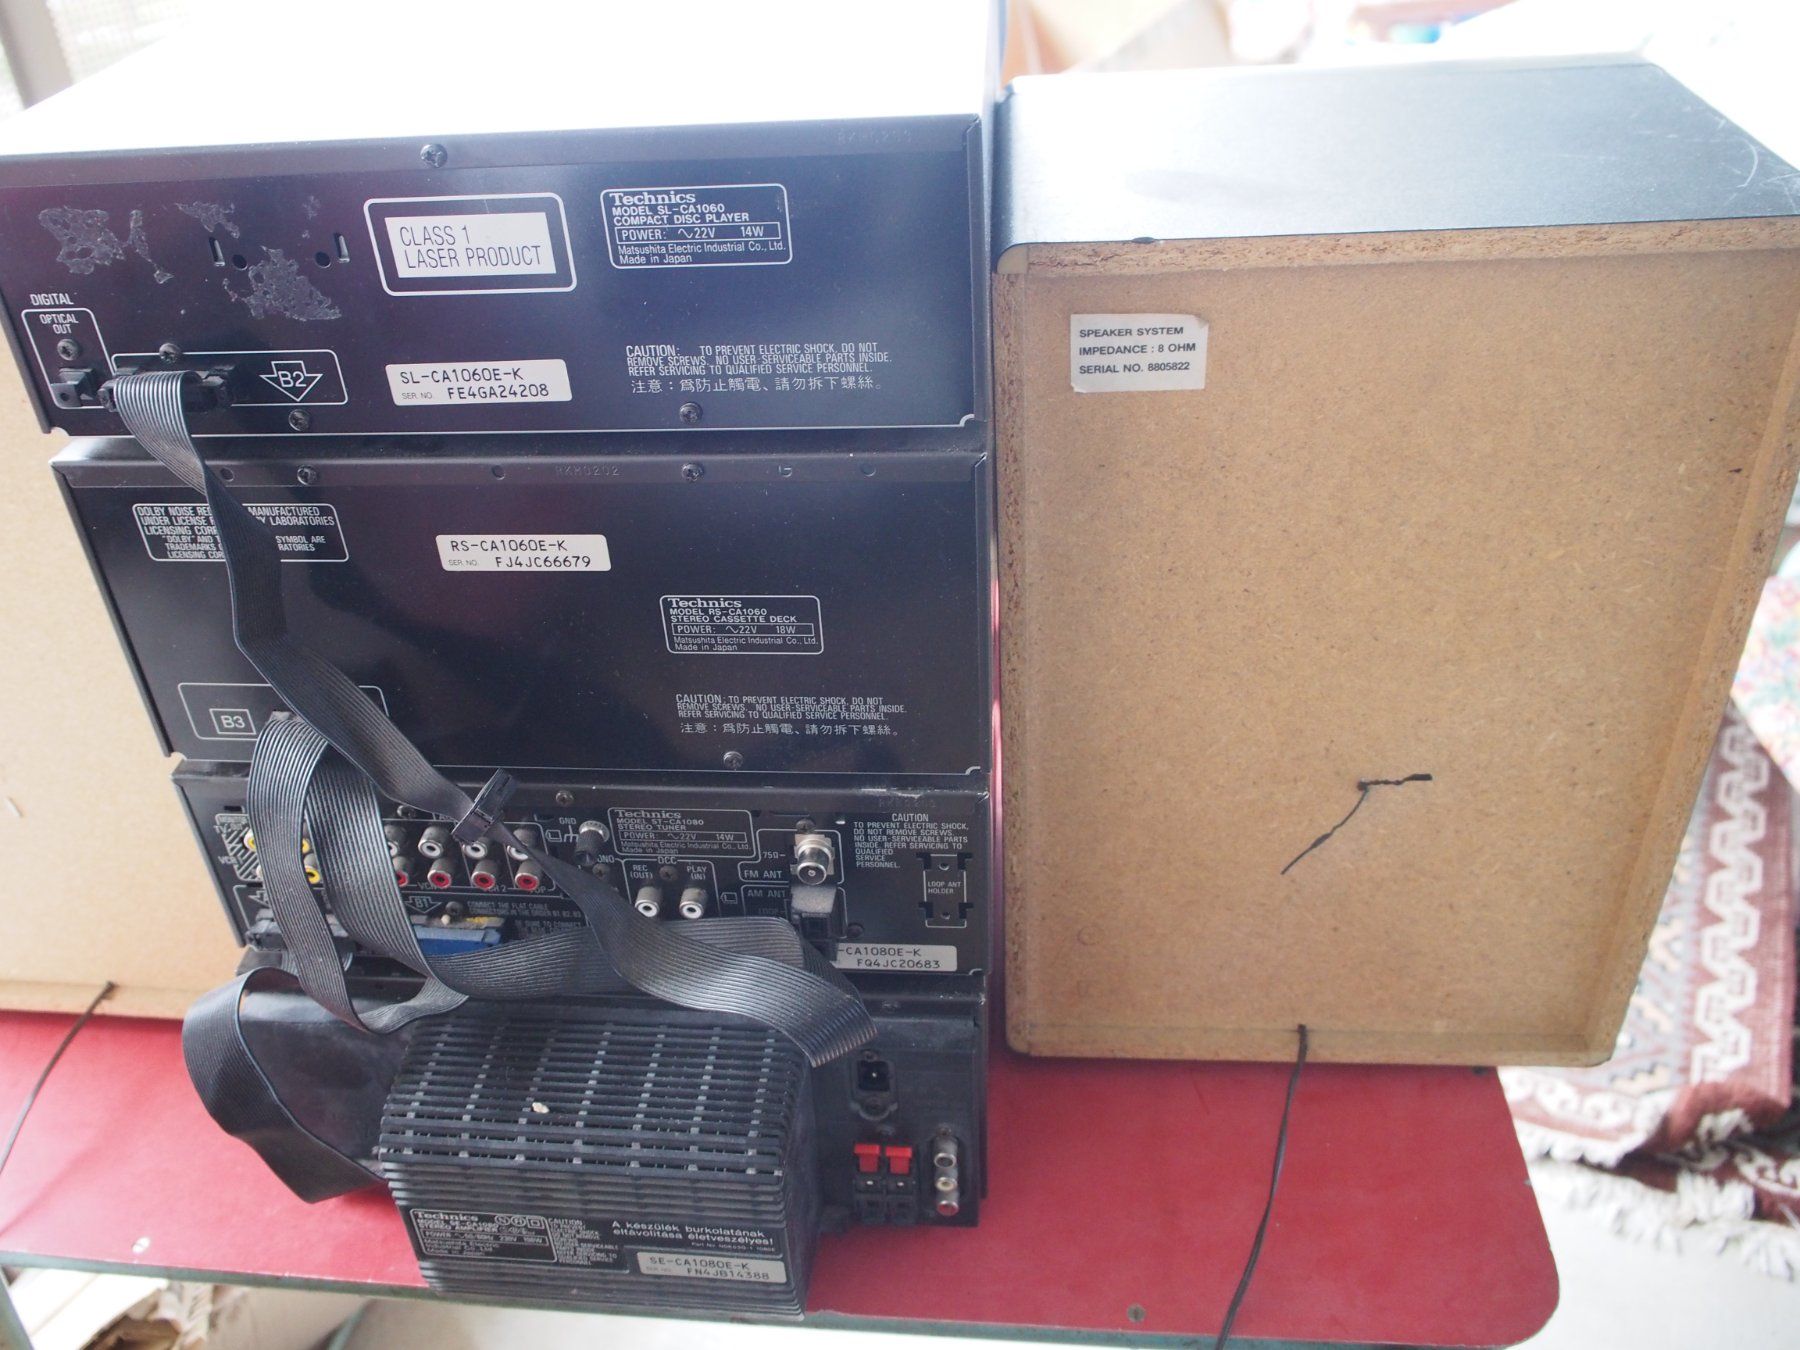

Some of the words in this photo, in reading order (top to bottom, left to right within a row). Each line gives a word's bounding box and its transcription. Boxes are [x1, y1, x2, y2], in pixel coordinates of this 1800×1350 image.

[609, 191, 696, 206] Technics
[612, 205, 651, 216] MODEL
[657, 203, 725, 215] SL-CA1060
[613, 214, 668, 226] COMPACT
[674, 213, 701, 224] DISC
[705, 212, 750, 223] PLAYER
[400, 225, 456, 247] CLASS
[462, 225, 471, 245] 1
[621, 229, 667, 241] POWER:
[741, 226, 764, 237] 14W
[618, 244, 666, 255] Matsushita
[668, 243, 702, 253] Electric
[704, 241, 745, 252] Industrial
[405, 247, 460, 269] LASER
[466, 245, 541, 267] PRODUCT
[619, 254, 647, 265] Made
[650, 254, 659, 263] in
[663, 253, 692, 264] Japan
[29, 293, 75, 306] DIGITAL
[39, 313, 79, 325] OPTICAL
[52, 324, 72, 334] OUT
[1079, 328, 1133, 338] SPEAKER
[1137, 327, 1184, 336] SYSTEM
[626, 345, 680, 357] CAUTION:
[700, 345, 713, 355] TO
[715, 345, 756, 355] PREVENT
[759, 344, 801, 354] ELECTRIC
[841, 343, 855, 353] DO
[859, 342, 878, 352] NOT
[1079, 345, 1148, 356] IMPEDANCE
[1157, 343, 1164, 353] 8
[1168, 343, 1197, 352] OHM
[627, 356, 664, 367] REMOVE
[715, 355, 729, 365] NO
[825, 352, 855, 363] PARTS
[859, 352, 892, 362] INSIDE.
[628, 366, 656, 376] REFER
[659, 365, 706, 376] SERVICING
[710, 365, 722, 375] TO
[725, 364, 772, 375] QUALIFIED
[776, 363, 813, 373] SERVICE
[817, 362, 873, 373] PERSONNEL.
[1079, 365, 1119, 374] SERIAL
[1123, 363, 1144, 373] NO.
[1147, 362, 1190, 372] 8805822
[277, 370, 306, 388] B2
[400, 367, 525, 384] SL-CA1060E-K
[447, 383, 550, 399] FE4GA24208
[137, 506, 165, 516] DOLBY
[168, 506, 196, 516] NOISE
[247, 506, 320, 516] MANUFACTURED
[141, 516, 171, 526] UNDER
[171, 516, 208, 525] LICENSE
[269, 516, 335, 526] LABORATORIES
[144, 525, 192, 535] LICENSING
[197, 535, 213, 543] AND
[275, 535, 309, 544] SYMBOL
[311, 535, 327, 544] ARE
[164, 543, 217, 551] TRADEMARKS
[450, 539, 568, 552] RS-CA1060E-K
[166, 551, 206, 559] LICENSING
[668, 597, 742, 608] Technics
[669, 608, 703, 616] MODEL
[708, 608, 768, 616] RS-CA1060
[671, 615, 710, 623] STEREO
[713, 615, 766, 623] CASSETTE
[769, 615, 797, 623] DECK
[775, 625, 796, 634] 18W
[673, 636, 716, 644] Matsushita
[717, 636, 746, 644] Electric
[748, 636, 783, 644] Industrial
[712, 644, 738, 652] Japan
[728, 695, 739, 704] TO
[742, 695, 777, 704] PREVENT
[780, 696, 817, 705] ELECTRIC
[852, 696, 864, 705] DO
[866, 696, 884, 705] NOT
[677, 703, 709, 711] REMOVE
[755, 703, 768, 711] NO
[850, 704, 876, 713] PARTS
[678, 710, 702, 718] REFER
[704, 711, 746, 719] SERVICING
[762, 711, 802, 720] QUALIFIED
[805, 711, 838, 720] SERVICE
[220, 715, 246, 728] B3
[614, 809, 681, 819] Technics
[891, 813, 929, 822] CAUTION
[559, 817, 577, 825] GND
[853, 821, 864, 829] TO
[867, 821, 900, 829] PREVENT
[903, 822, 938, 830] ELECTRIC
[855, 848, 893, 856] QUALIFIED
[633, 864, 649, 872] REC
[686, 865, 707, 873] PLAY
[630, 871, 653, 880] (OUT)
[744, 869, 759, 878] FM
[763, 870, 783, 879] ANT
[747, 889, 763, 897] AM
[767, 889, 786, 898] ANT
[857, 958, 941, 969] FQ4JC20683
[414, 1211, 479, 1222] Technics
[612, 1220, 621, 1228] A
